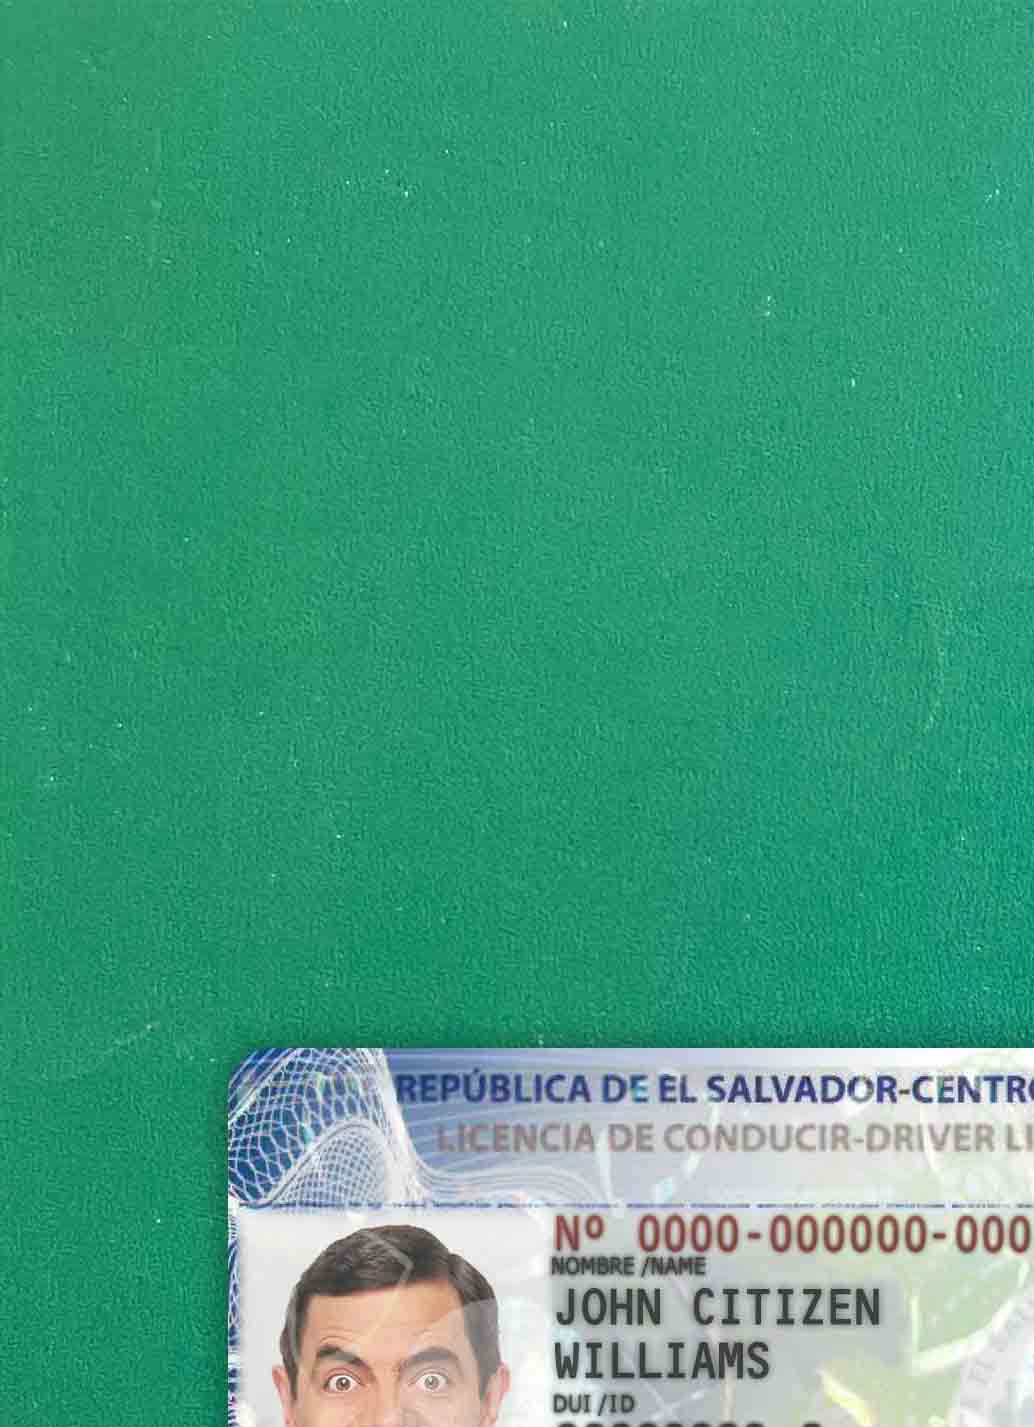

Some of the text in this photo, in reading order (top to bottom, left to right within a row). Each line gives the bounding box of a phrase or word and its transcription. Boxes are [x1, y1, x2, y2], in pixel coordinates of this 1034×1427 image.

[396, 1070, 590, 1103] REPÚBLICA
[602, 1075, 650, 1103] DE
[659, 1075, 696, 1103] EL
[437, 1122, 595, 1152] LICENCIA
[608, 1122, 653, 1152] DE
[663, 1121, 996, 1153] CONDUCIR-DRIVER
[551, 1255, 707, 1278] NOMBRE /NAME
[555, 1286, 882, 1327] JOHN CITIZEN
[554, 1340, 771, 1381] WILLIAMS
